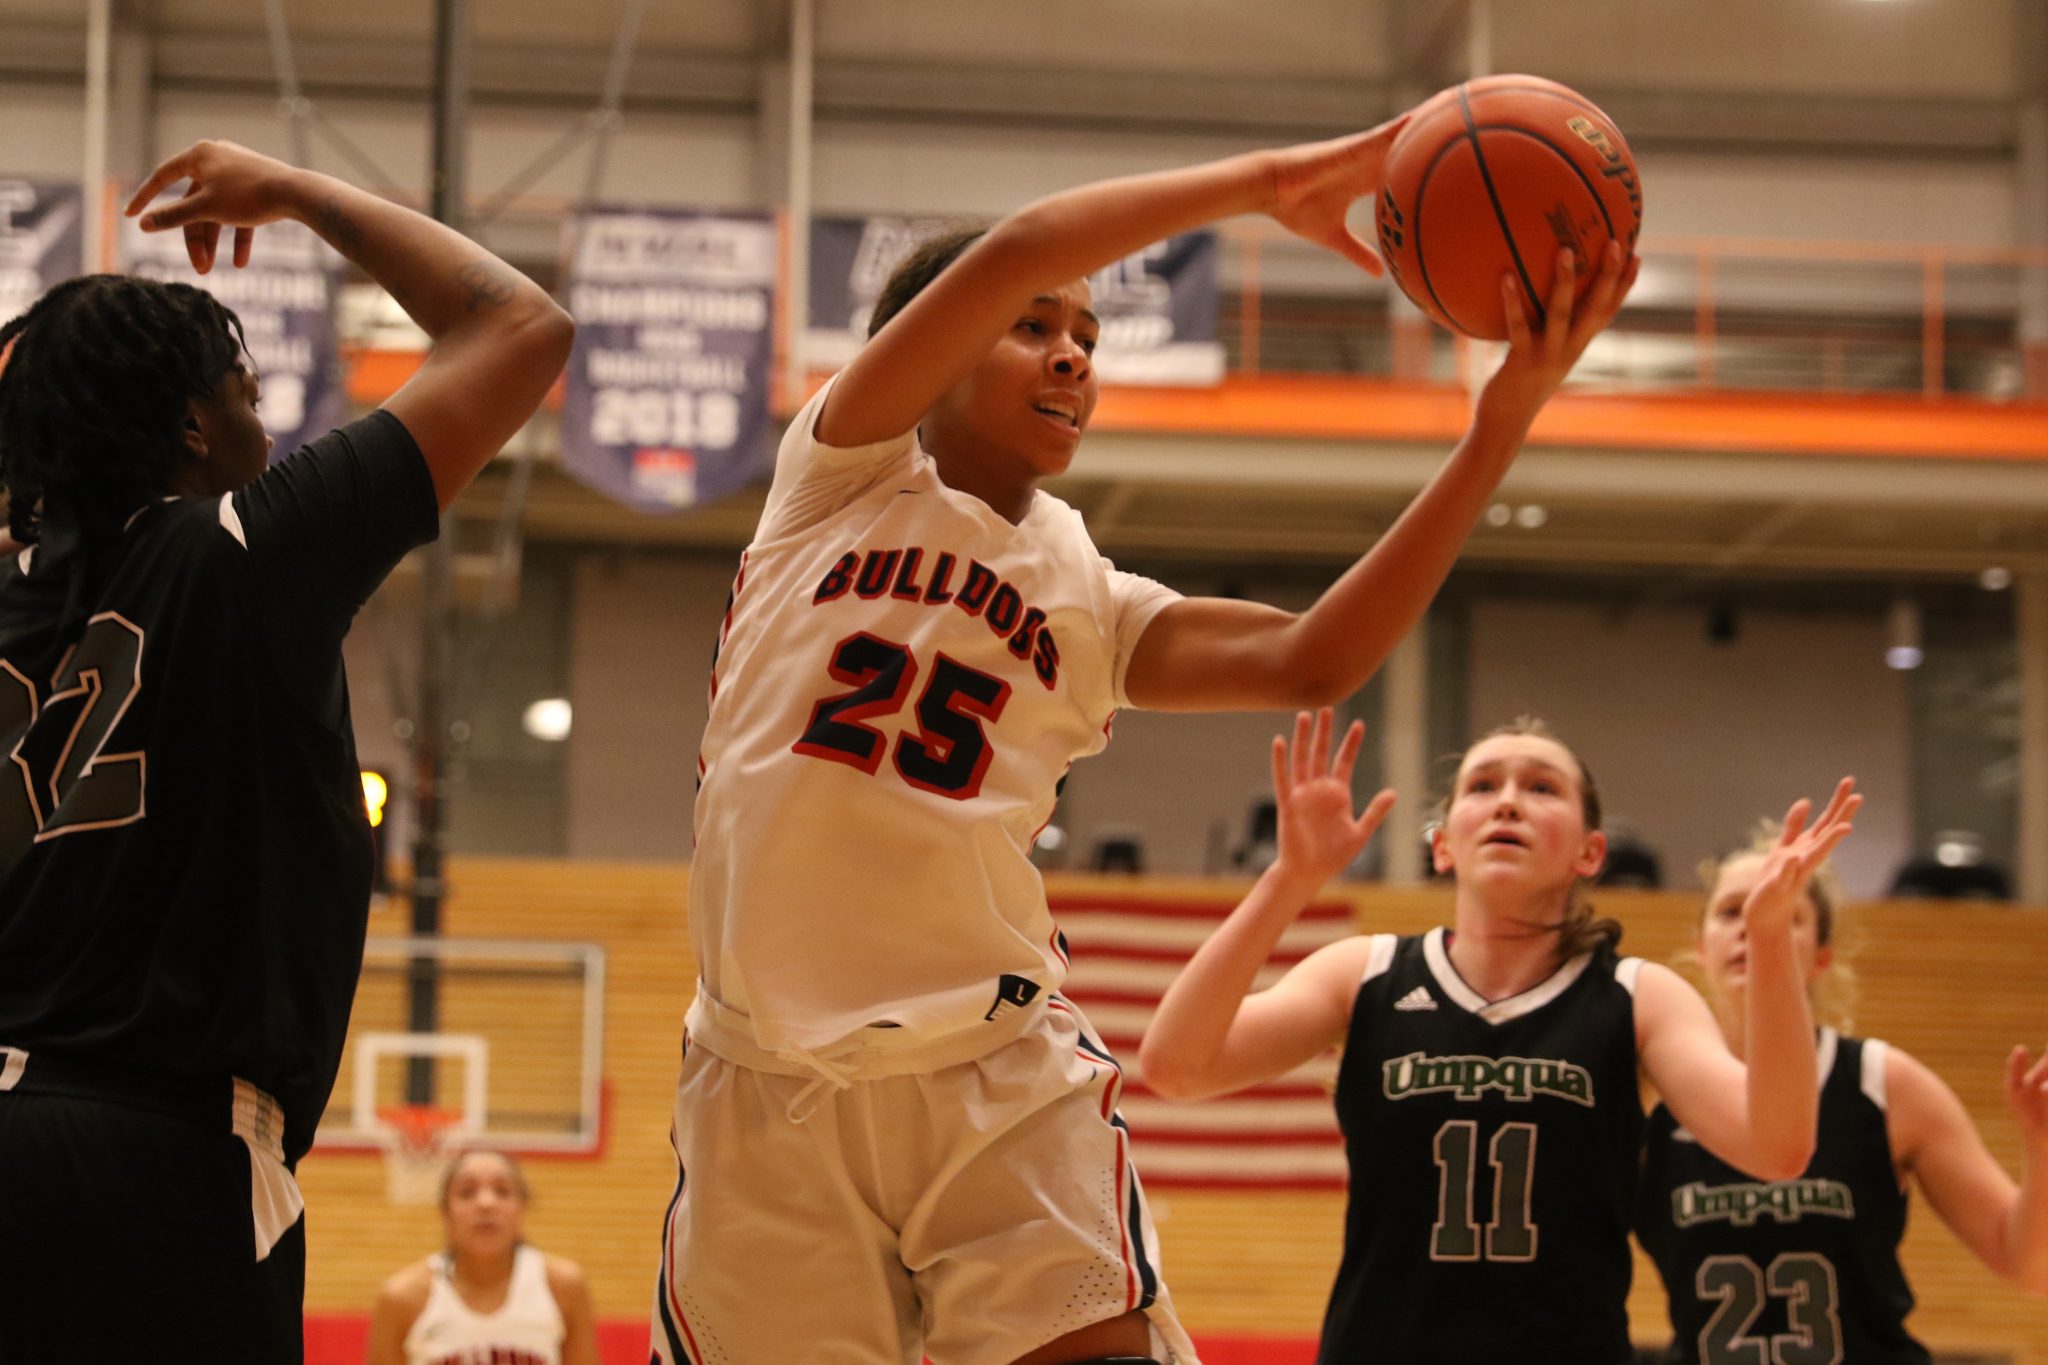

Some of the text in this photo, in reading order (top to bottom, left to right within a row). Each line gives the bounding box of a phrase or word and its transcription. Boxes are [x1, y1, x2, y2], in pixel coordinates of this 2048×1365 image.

[812, 547, 1060, 691] BULLDOGS
[791, 630, 1012, 801] 25
[1382, 1051, 1595, 1108] Umpqua
[1430, 1120, 1538, 1262] 11
[1670, 1179, 1855, 1228] Umpqua
[1695, 1251, 1844, 1365] 23
